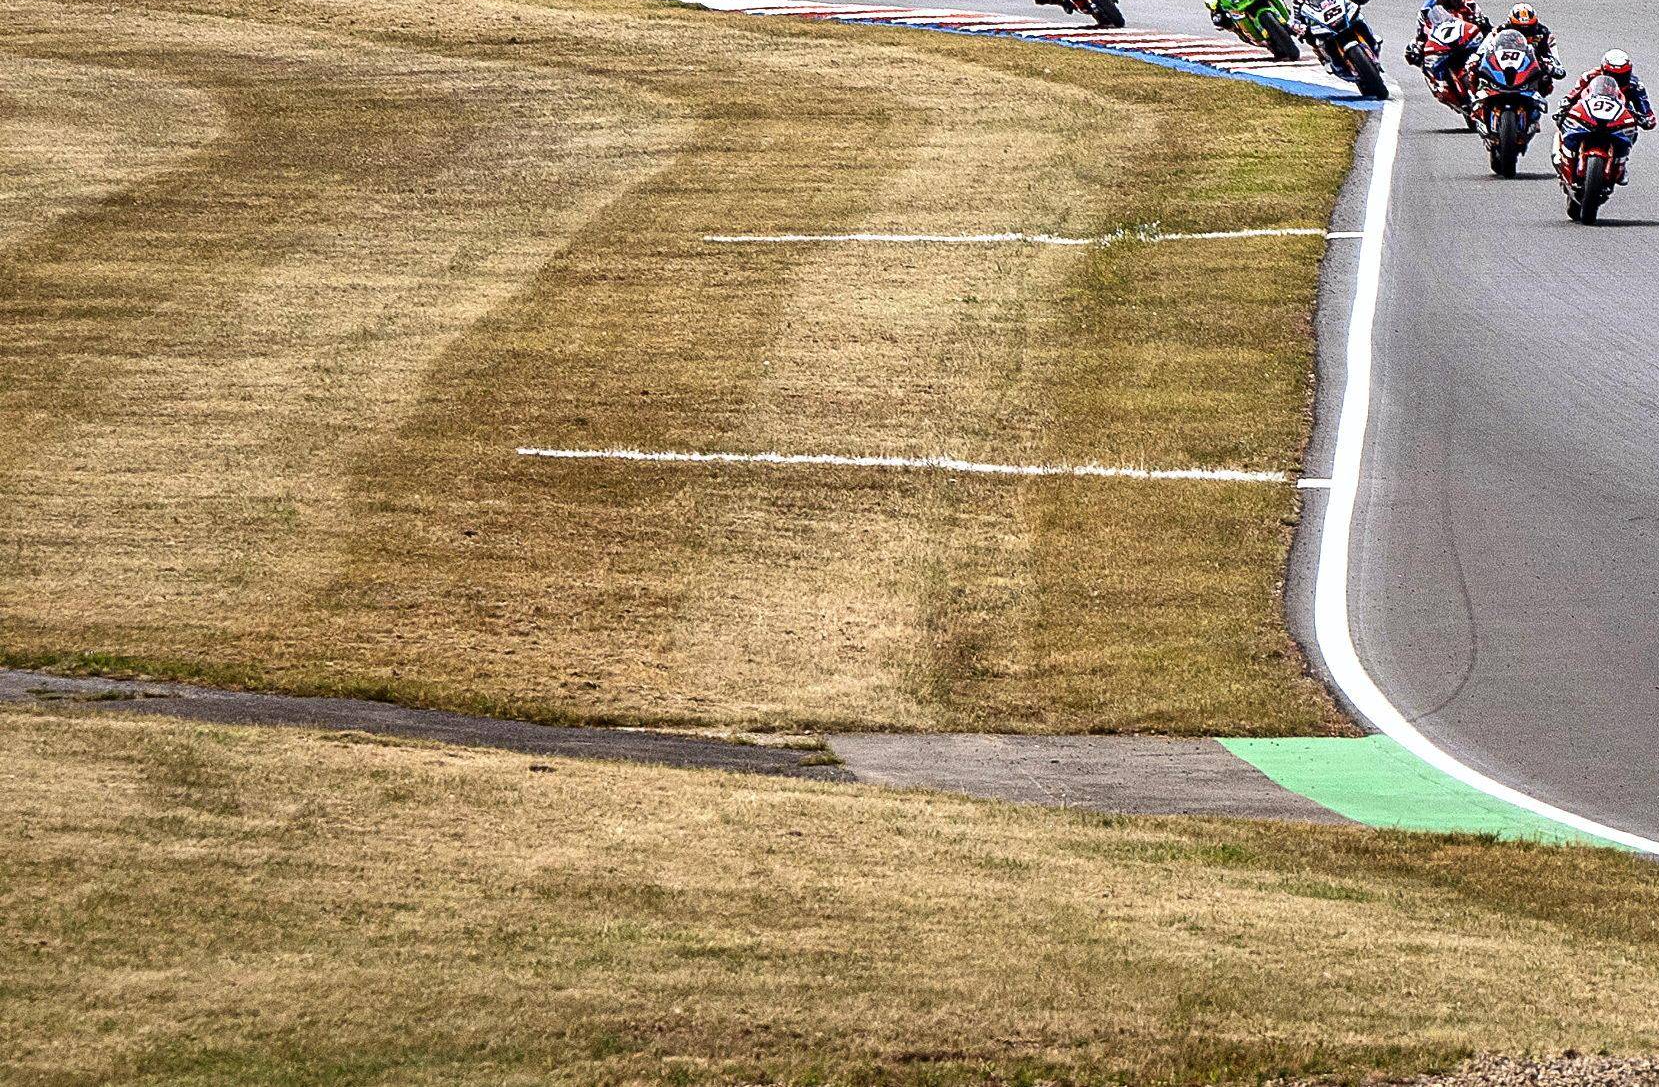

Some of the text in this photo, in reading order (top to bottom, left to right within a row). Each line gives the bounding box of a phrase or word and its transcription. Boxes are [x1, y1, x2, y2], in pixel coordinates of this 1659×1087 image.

[1441, 26, 1455, 41] 7
[1500, 51, 1521, 62] 60
[1593, 100, 1616, 112] 97
